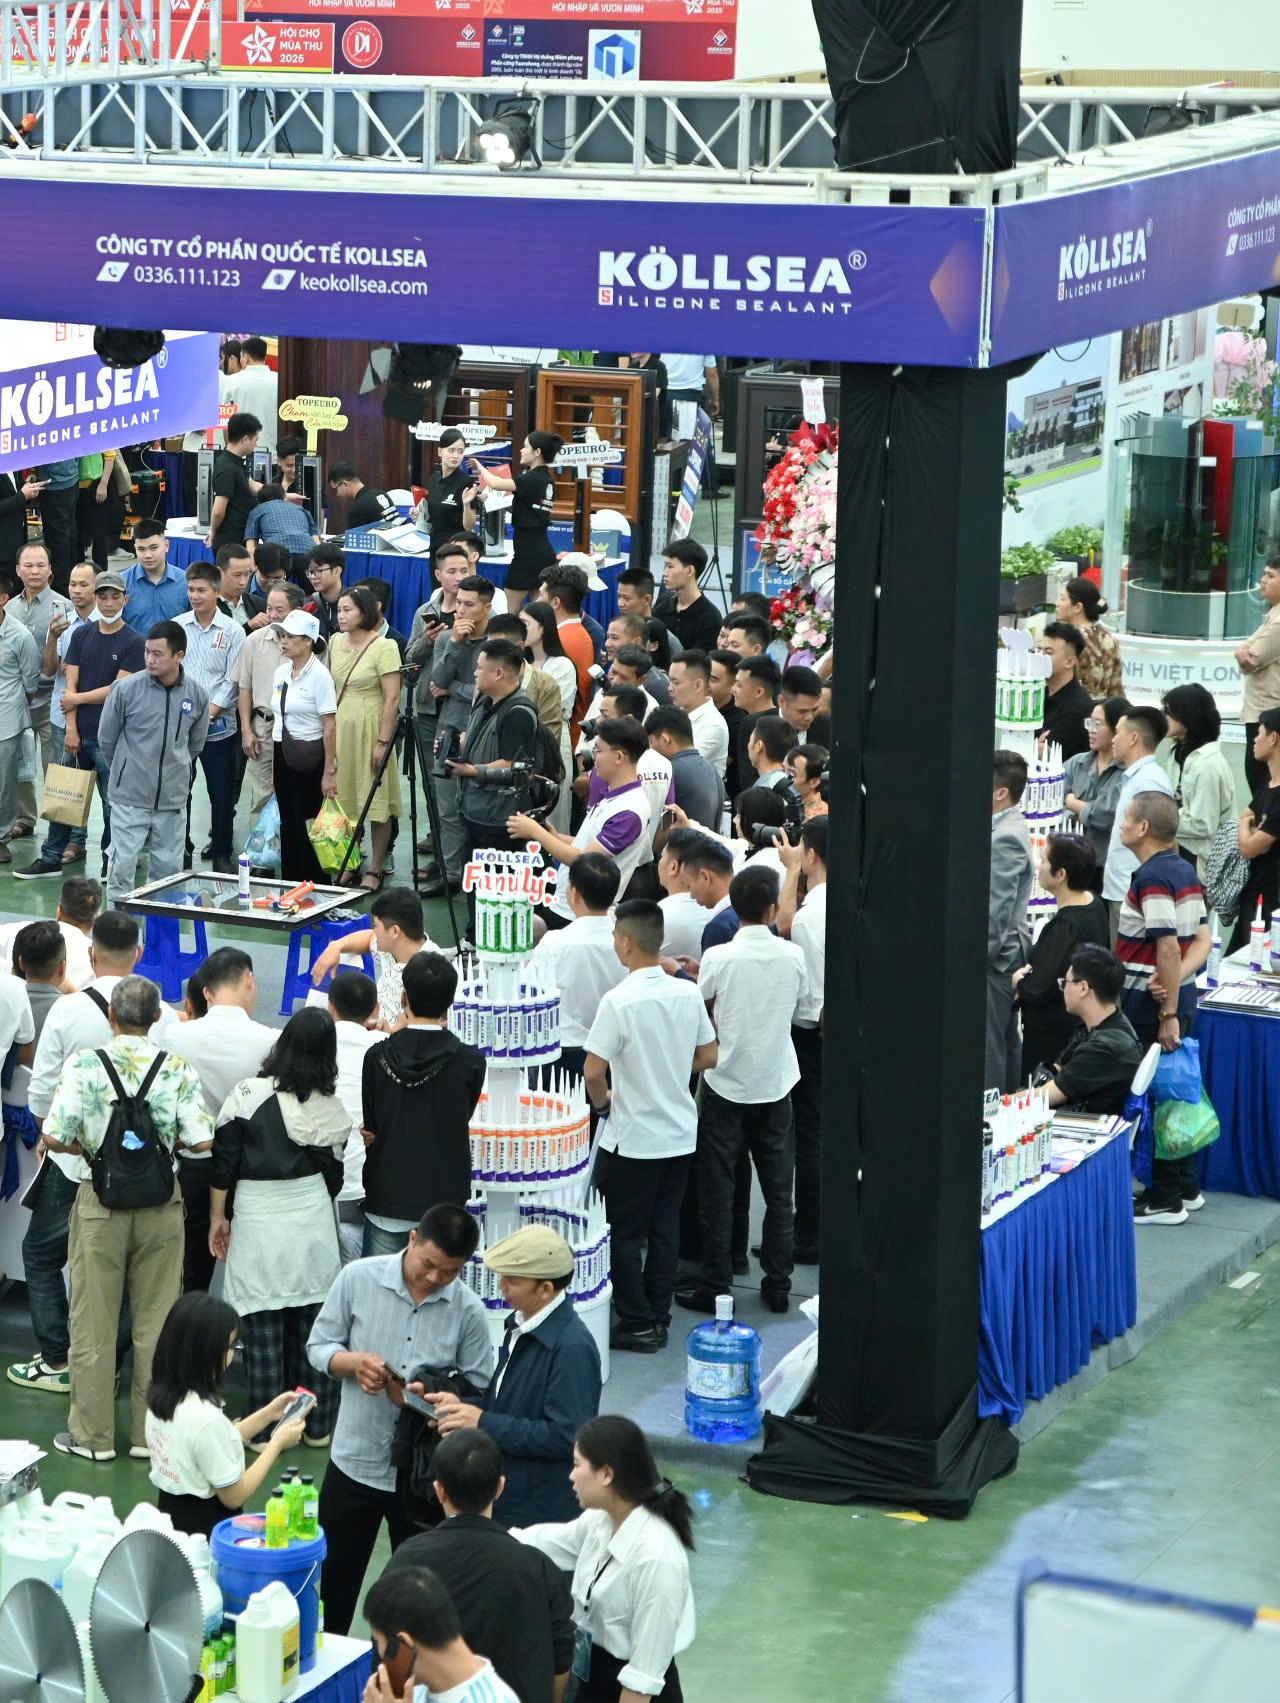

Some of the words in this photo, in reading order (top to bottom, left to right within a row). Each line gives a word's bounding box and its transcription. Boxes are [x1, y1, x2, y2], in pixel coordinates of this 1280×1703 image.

[279, 27, 298, 39] HỘI
[299, 27, 321, 40] CHỢ
[303, 41, 323, 51] THU
[279, 53, 305, 64] 2025
[95, 233, 148, 256] CÔNG
[150, 238, 174, 257] TY
[261, 239, 316, 264] QUỐC
[318, 241, 343, 265] TẾ
[344, 246, 428, 268] KOLLSEA
[1059, 228, 1147, 282] KÖLLSEA
[133, 265, 241, 288] 0336.111.123
[300, 272, 428, 296] keokollsea.com
[598, 245, 852, 295] KÖLLSEA
[1058, 279, 1103, 301] SILICONE
[1106, 269, 1147, 289] SEALANT
[598, 287, 721, 311] SILICONE
[736, 299, 853, 315] SEALANT
[0, 358, 160, 431] KÖLLSEA
[297, 399, 338, 408] TOPEURO
[0, 425, 81, 455] SILICONE
[89, 408, 161, 436] SEALANT
[559, 444, 607, 456] OPEURO
[1150, 662, 1194, 684] VIỆT
[1201, 666, 1242, 682] LON
